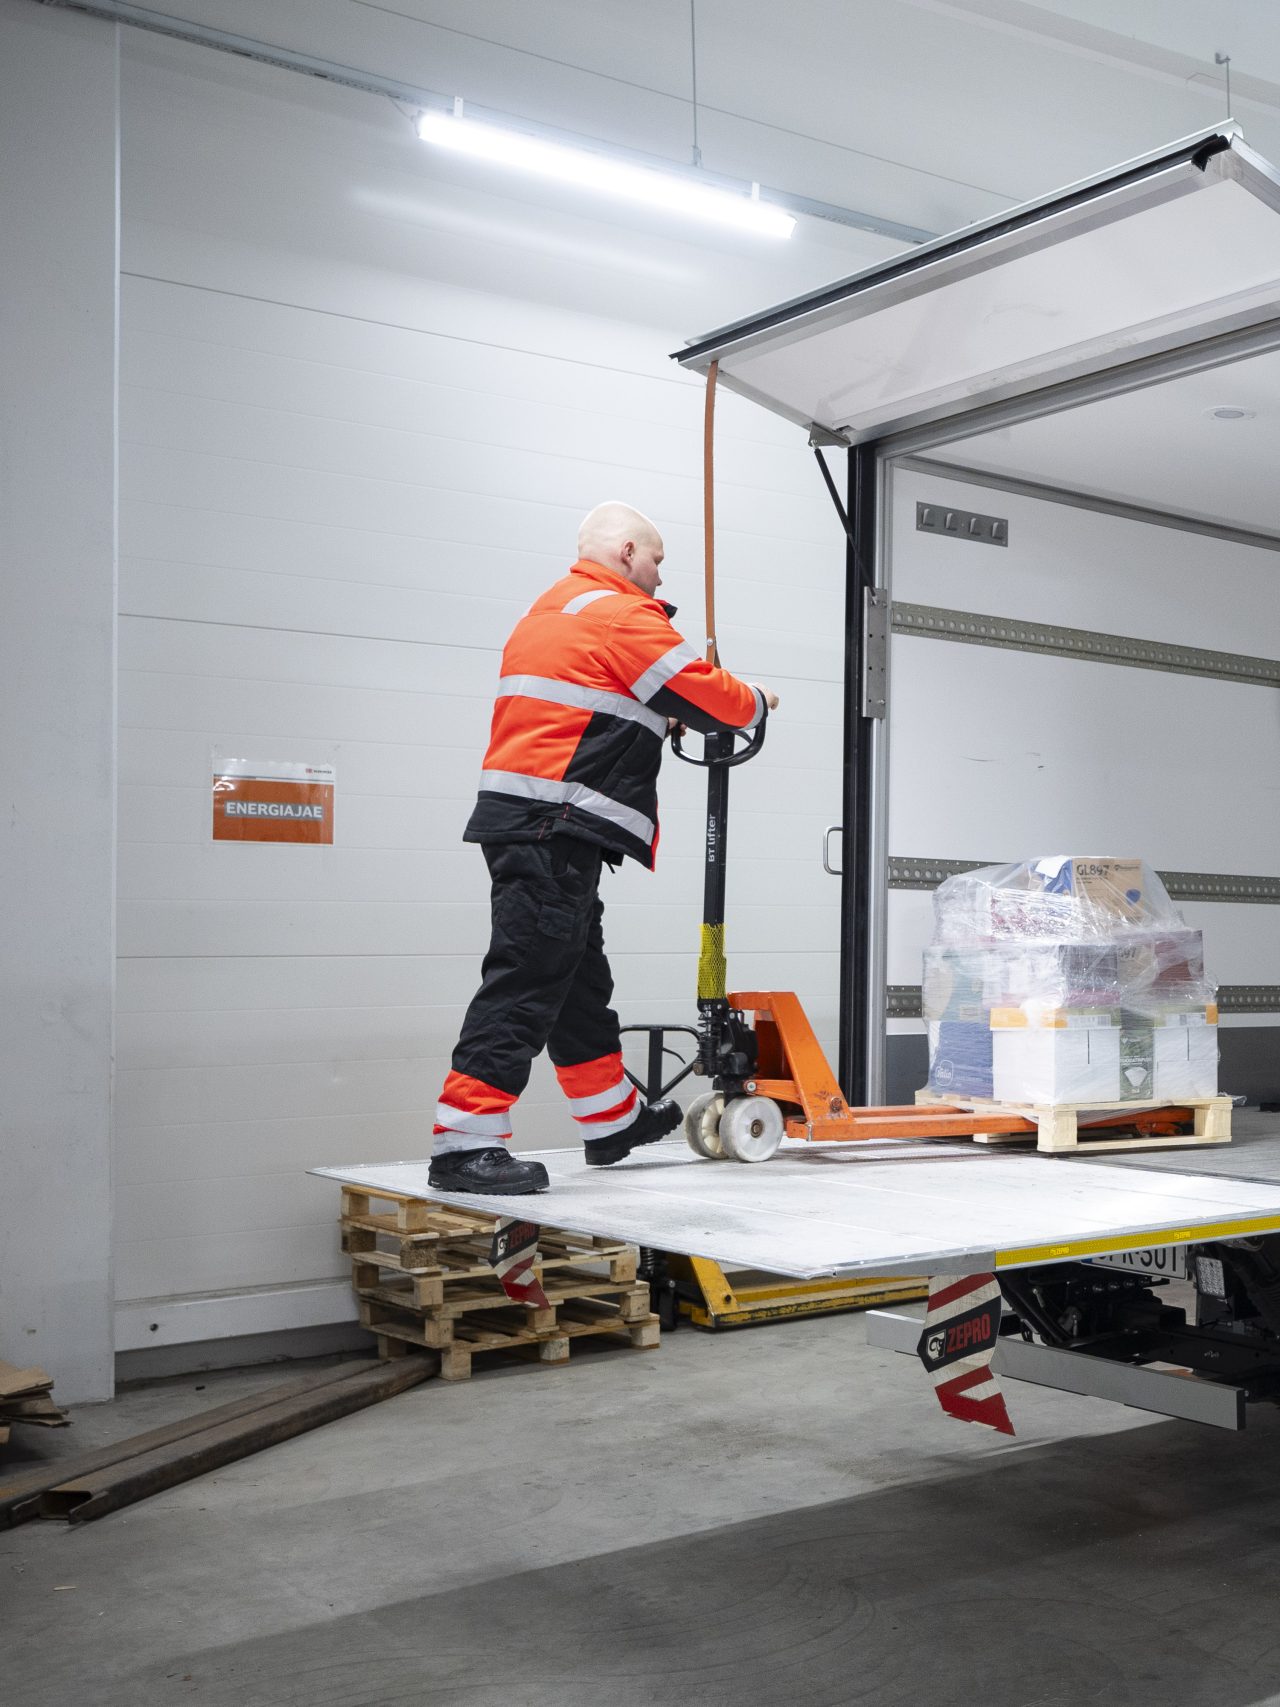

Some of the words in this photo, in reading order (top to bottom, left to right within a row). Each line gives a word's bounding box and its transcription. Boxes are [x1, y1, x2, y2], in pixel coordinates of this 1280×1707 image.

[226, 802, 322, 818] ENERGIAJAE
[707, 813, 716, 845] lifter
[708, 848, 715, 862] BT
[946, 1313, 991, 1353] ZEPRO
